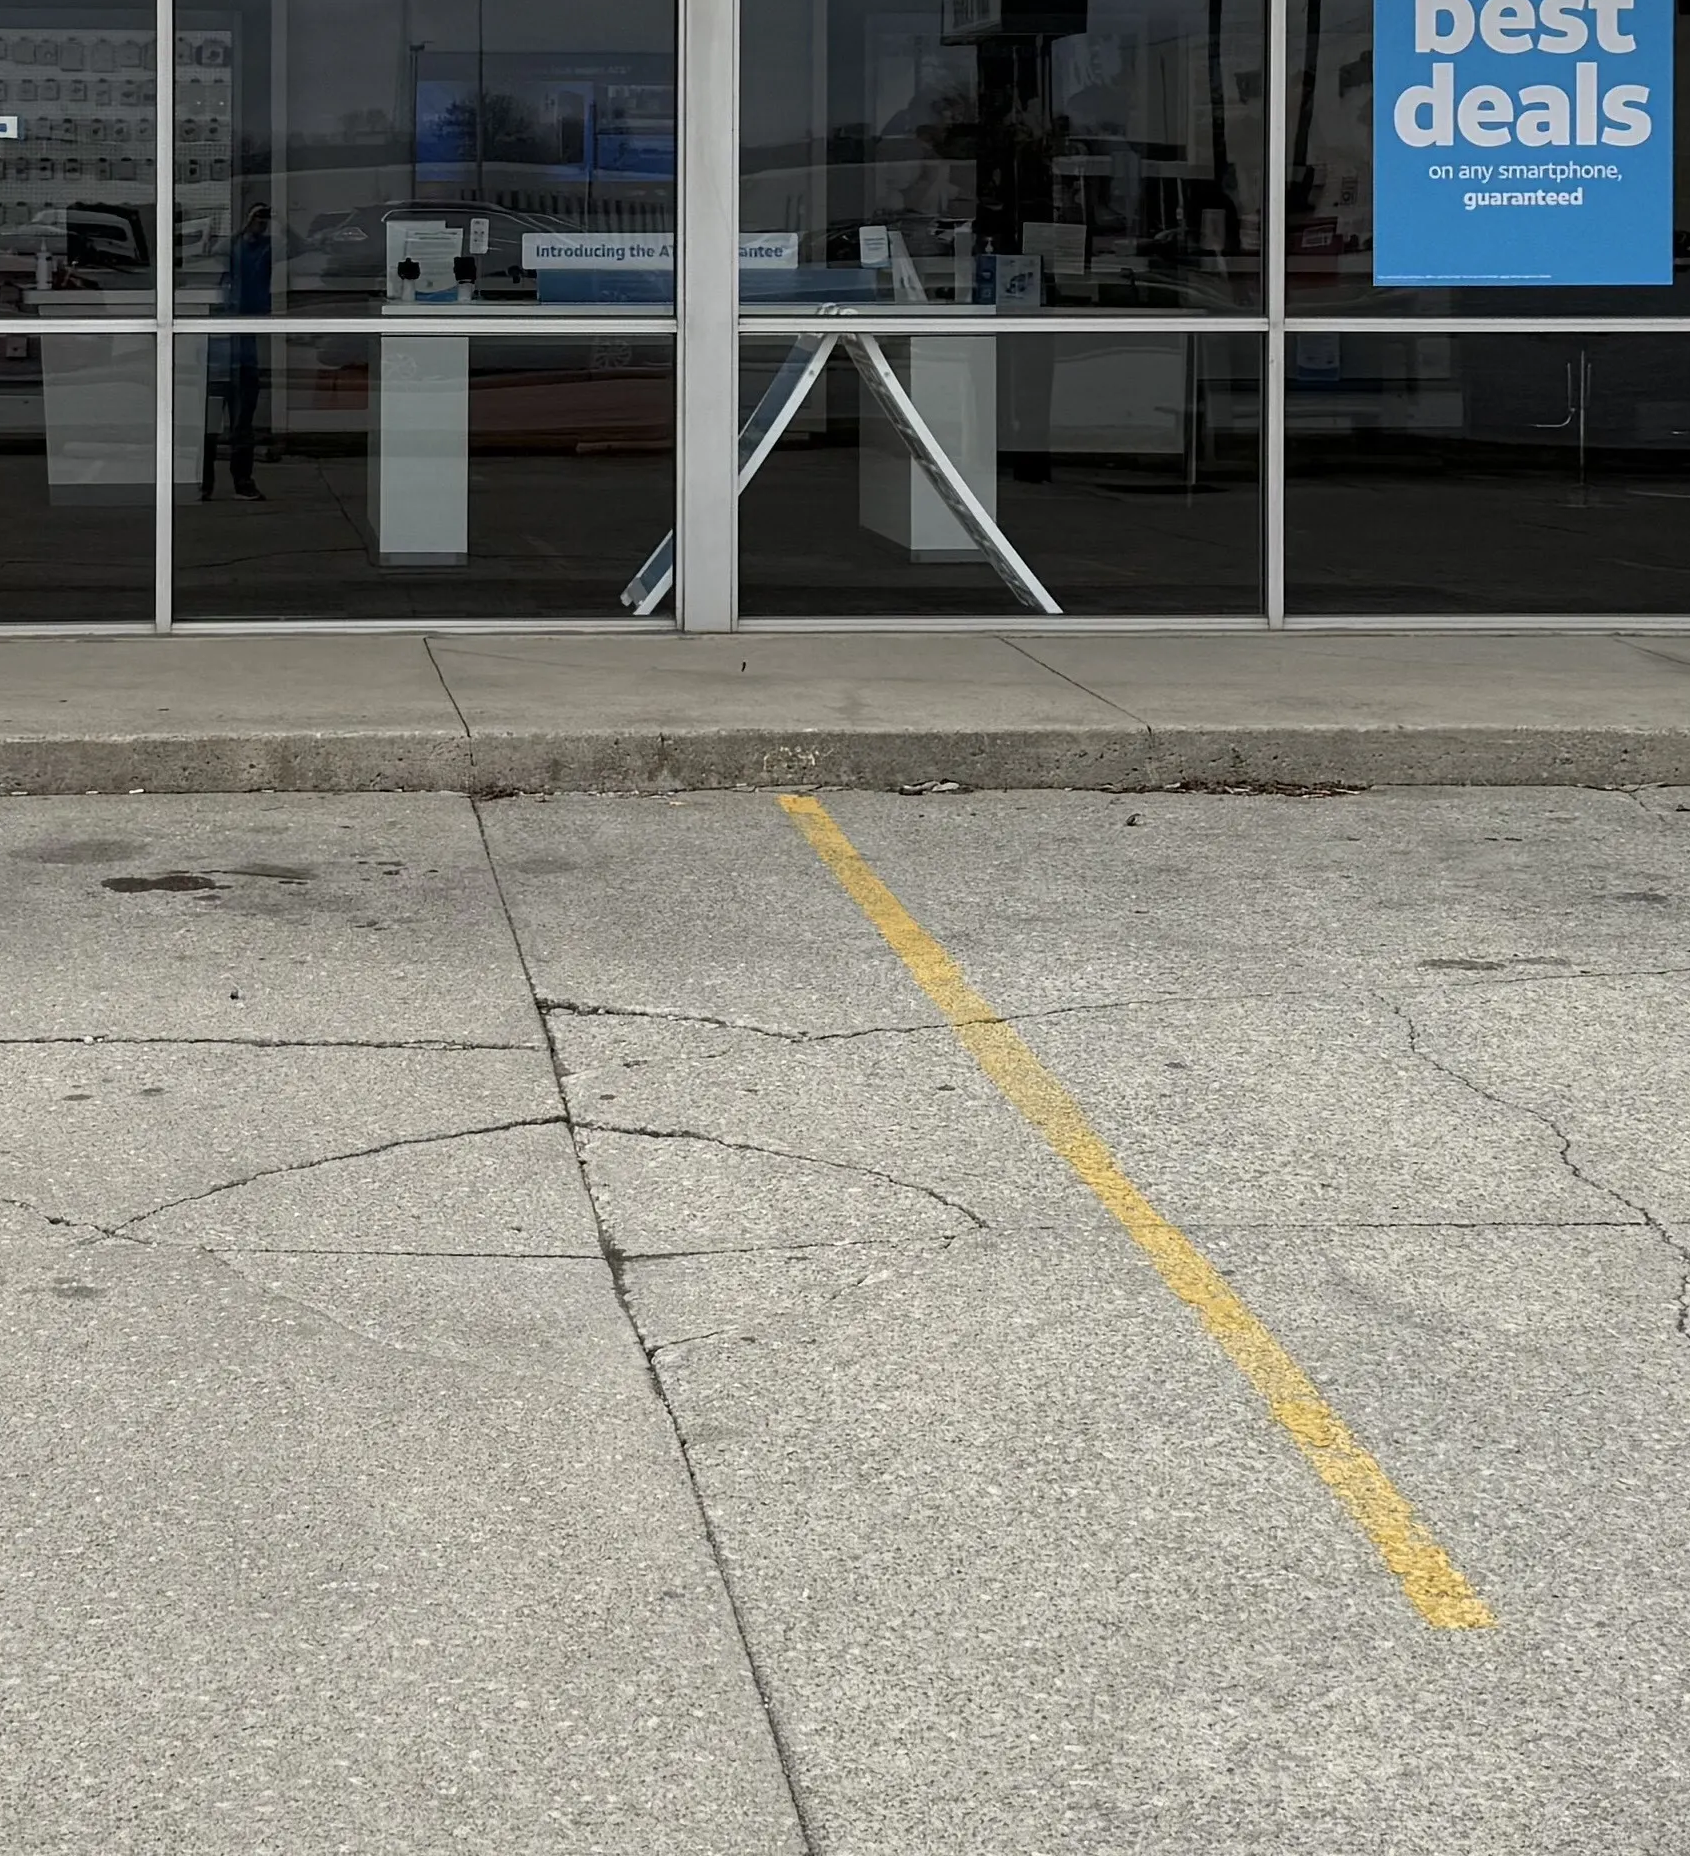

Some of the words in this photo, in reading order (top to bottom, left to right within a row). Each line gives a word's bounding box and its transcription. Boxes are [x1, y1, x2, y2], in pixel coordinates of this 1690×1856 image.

[1393, 62, 1652, 147] deals
[1429, 165, 1454, 179] on
[1458, 165, 1493, 184] any
[1498, 160, 1623, 184] smartphone,
[1463, 187, 1583, 211] guaranteed
[536, 244, 626, 261] Introducing
[629, 245, 655, 258] the
